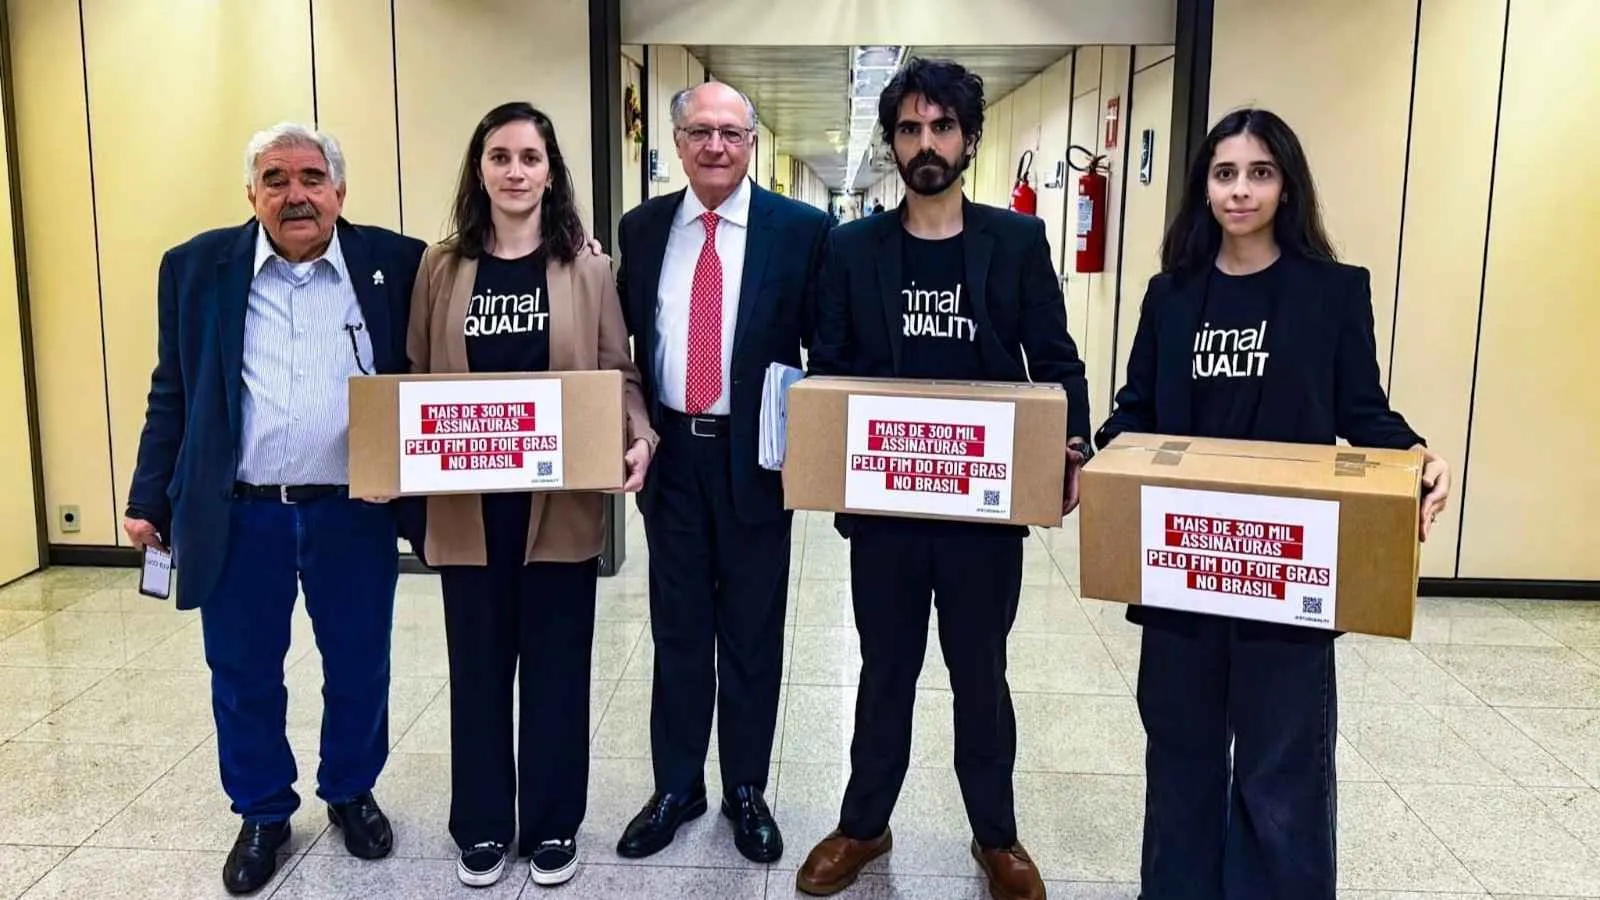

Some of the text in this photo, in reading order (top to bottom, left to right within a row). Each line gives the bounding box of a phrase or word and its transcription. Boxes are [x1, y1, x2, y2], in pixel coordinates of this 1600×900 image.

[464, 313, 548, 337] QUALIT
[1192, 352, 1269, 379] UALIT
[428, 404, 528, 419] MAIS DE 300 MIL
[435, 419, 519, 434] ASSINATURAS
[876, 422, 977, 440] MAIS DE 300 MIL
[406, 436, 556, 454] PELO FIM DO FOIE GRAS
[881, 438, 967, 455] ASSINATURAS
[448, 455, 516, 469] NO BRASIL
[852, 456, 1006, 478] PELO FIM DO FOIE GRAS
[893, 476, 962, 493] NO BRASIL
[1173, 516, 1295, 541] MAIS DE 300 MIL
[1180, 534, 1282, 556] ASSINATURAS
[1148, 551, 1329, 584] PELO FIM DO FOIE GRAS
[1196, 575, 1276, 598] NO BRASIL
